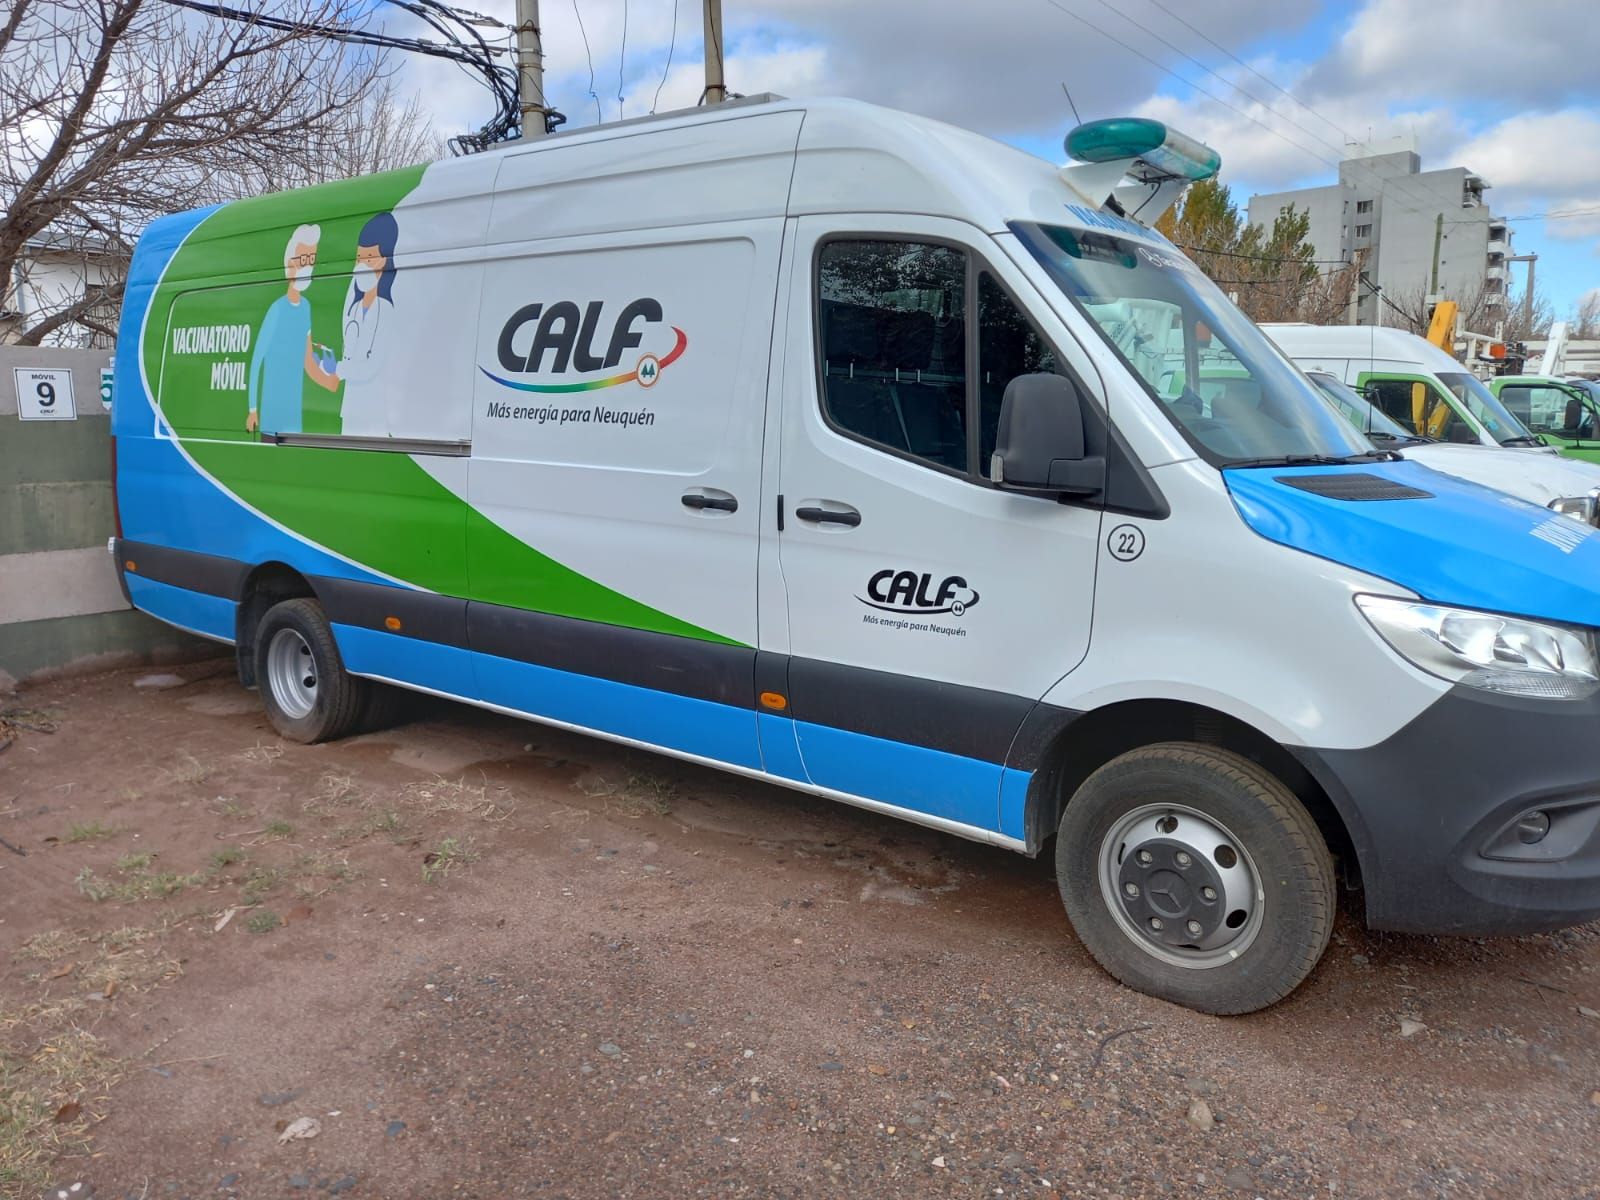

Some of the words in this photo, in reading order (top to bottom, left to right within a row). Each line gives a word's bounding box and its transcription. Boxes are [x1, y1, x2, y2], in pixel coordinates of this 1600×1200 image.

[173, 324, 250, 354] VACUNATORIO
[497, 298, 663, 374] CALF
[210, 357, 247, 391] MÓVIL
[36, 381, 55, 407] 9
[487, 402, 511, 419] Más
[513, 404, 558, 424] energía
[560, 408, 591, 425] para
[593, 406, 655, 428] Neuquén
[1117, 533, 1136, 553] 22
[867, 569, 968, 607] CALF
[862, 614, 879, 625] Más
[879, 617, 909, 630] energía
[909, 622, 929, 632] para
[929, 623, 967, 637] Neuquén
